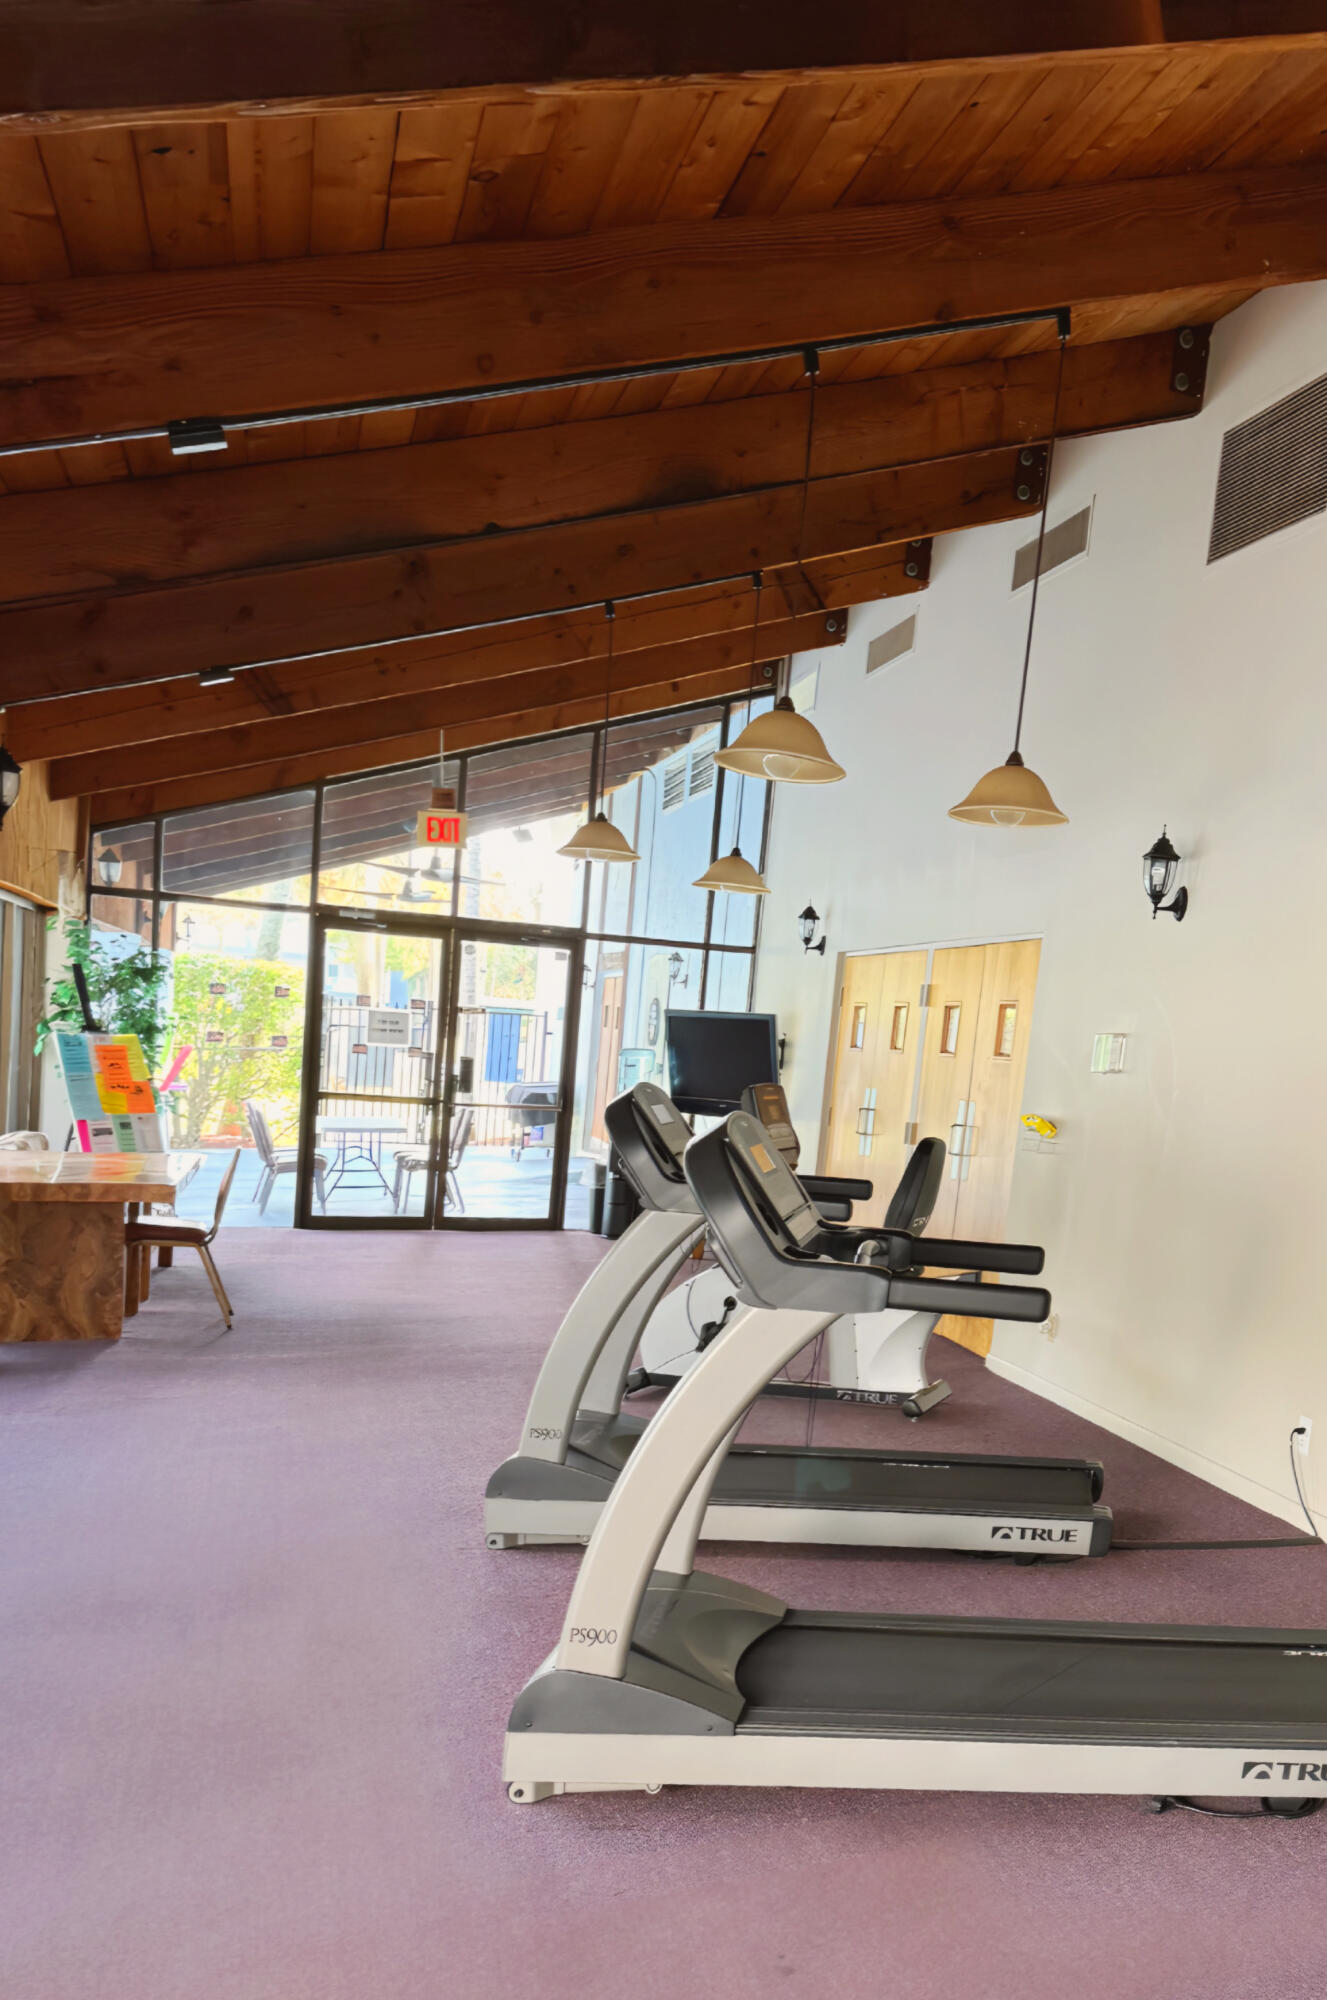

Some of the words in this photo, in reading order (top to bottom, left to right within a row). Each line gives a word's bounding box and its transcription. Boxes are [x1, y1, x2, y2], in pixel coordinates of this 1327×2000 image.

[426, 816, 461, 844] EXIT
[855, 1391, 898, 1405] TRUE
[1015, 1526, 1078, 1543] TRUE
[569, 1627, 618, 1647] PS900
